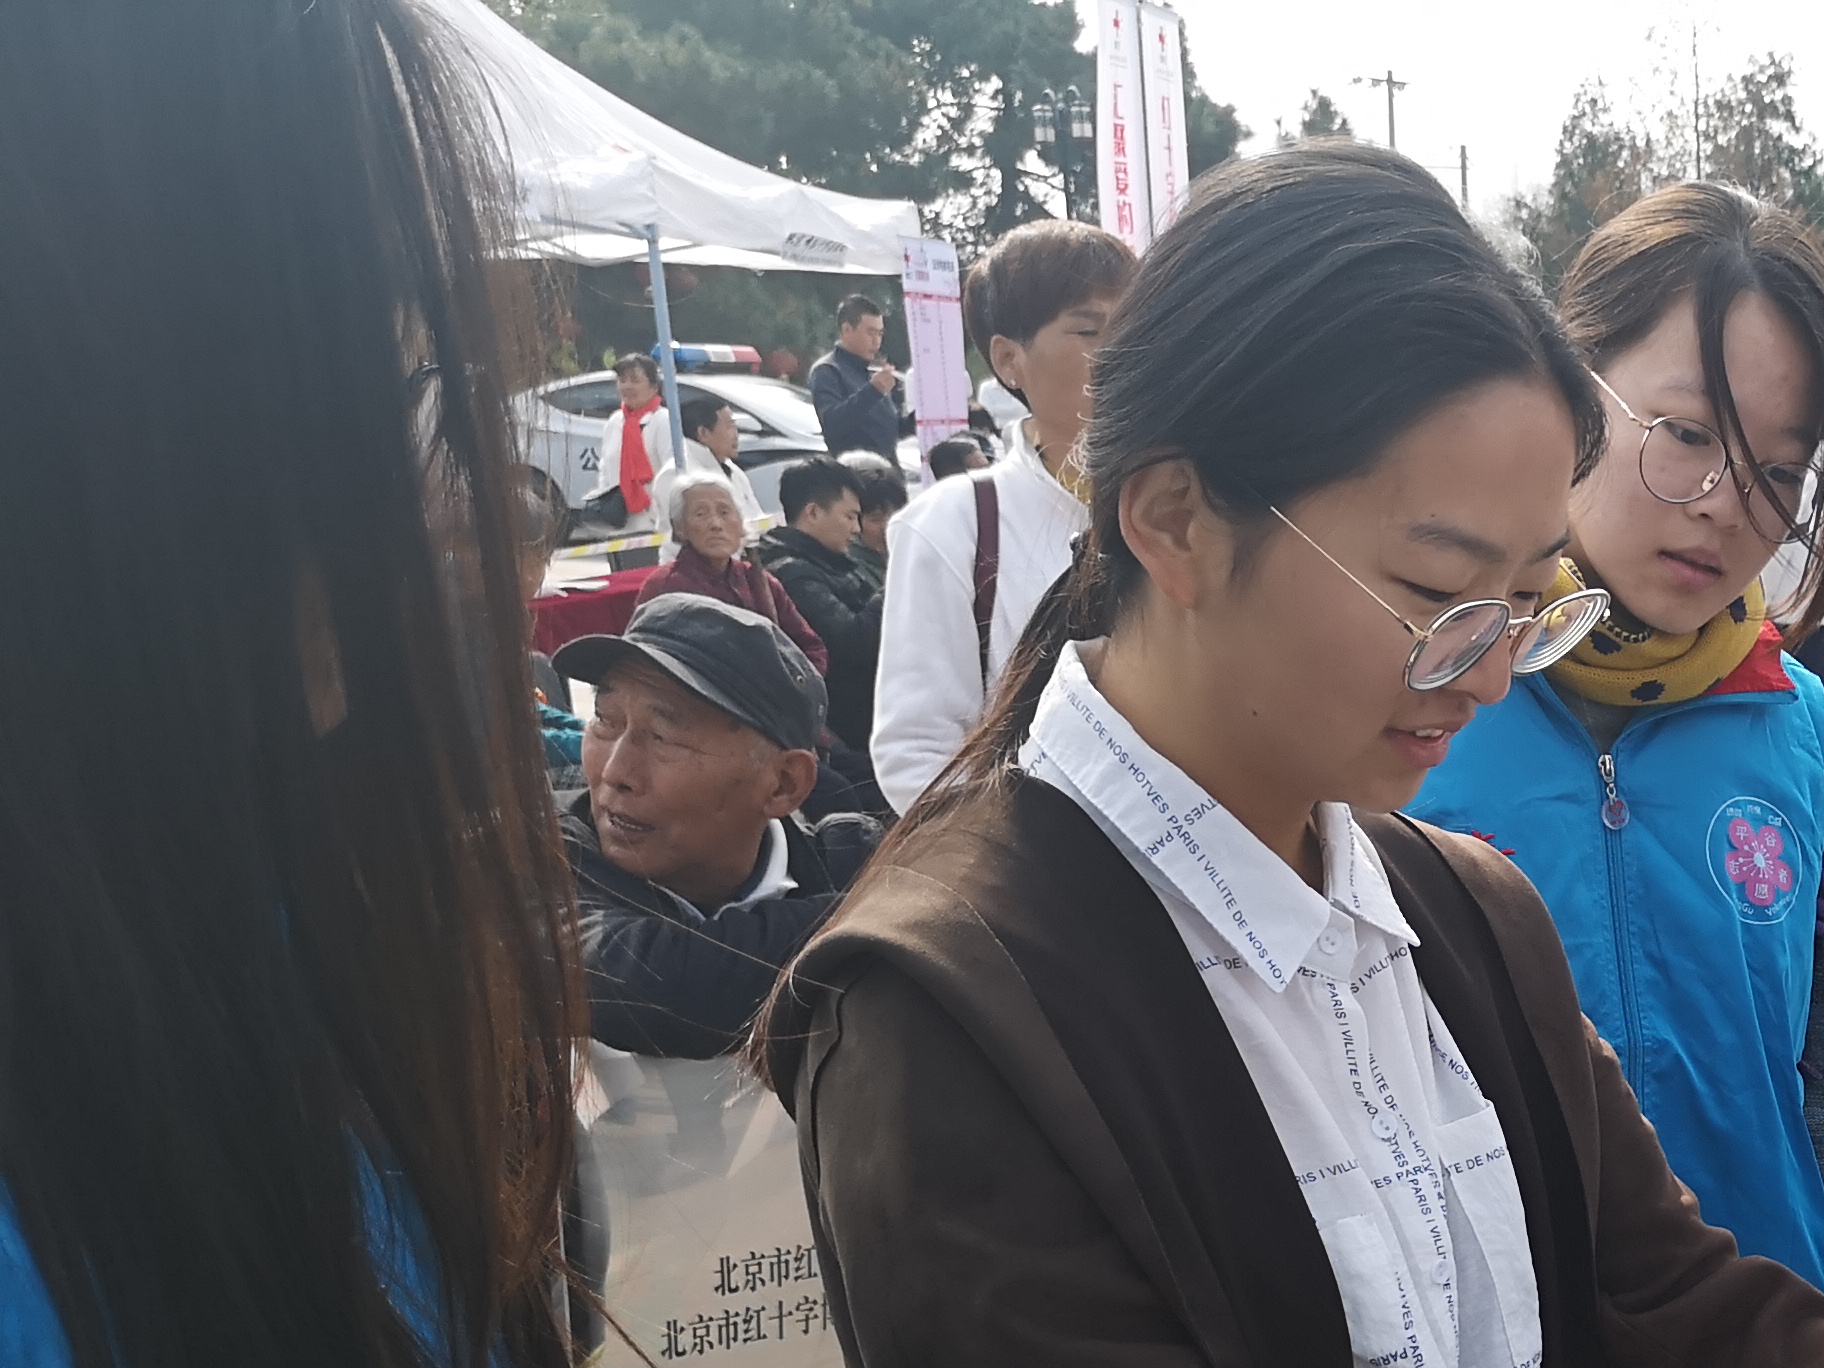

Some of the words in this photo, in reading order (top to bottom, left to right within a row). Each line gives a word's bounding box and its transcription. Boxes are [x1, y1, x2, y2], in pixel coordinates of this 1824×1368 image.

[579, 447, 600, 471] 公
[1093, 720, 1108, 740] DE
[1106, 737, 1130, 764] NOS
[1128, 762, 1170, 814] HOTVES
[1166, 815, 1201, 855] PARIS
[1202, 861, 1237, 910] VILLITE
[1232, 909, 1249, 930] DE
[1245, 931, 1269, 960] NOS
[1327, 982, 1348, 1020] PARIS
[1341, 1030, 1360, 1077] VILLITE
[1352, 1081, 1366, 1099] DE
[1408, 1179, 1432, 1216] PARIS
[1466, 1155, 1484, 1171] DE
[714, 1244, 819, 1297] 北京市红
